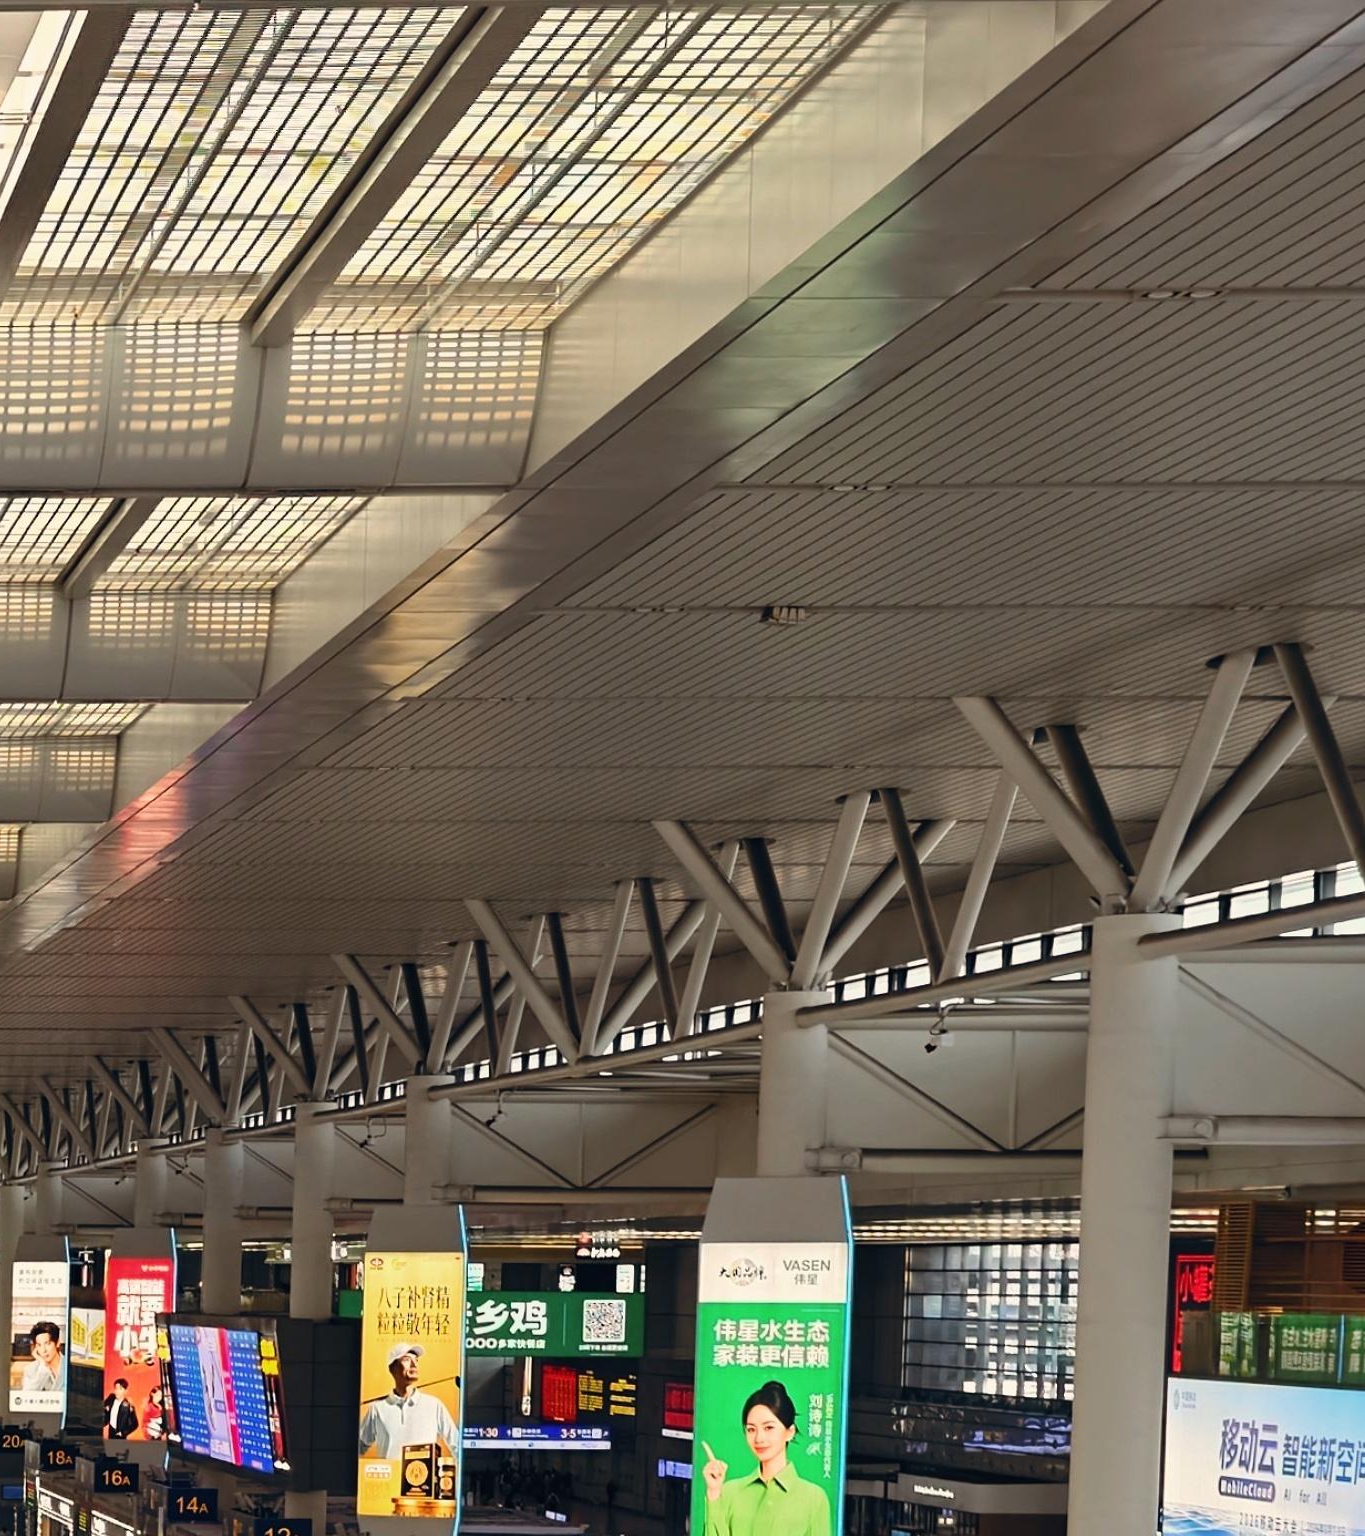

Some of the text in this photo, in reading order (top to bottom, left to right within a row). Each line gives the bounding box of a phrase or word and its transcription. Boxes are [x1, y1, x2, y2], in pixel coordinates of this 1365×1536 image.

[782, 1259, 831, 1272] VASEN
[794, 1273, 818, 1286] 伟星
[378, 1285, 450, 1309] 八子补肾精
[713, 1319, 830, 1343] 伟星水生态
[712, 1344, 830, 1369] 家装更信赖
[808, 1393, 823, 1438] 刘诗诗
[47, 1450, 73, 1465] 18A
[1220, 1417, 1278, 1476] 移动云
[101, 1470, 131, 1487] 16A
[1220, 1478, 1274, 1500] MobileCloud
[175, 1496, 209, 1514] 14A
